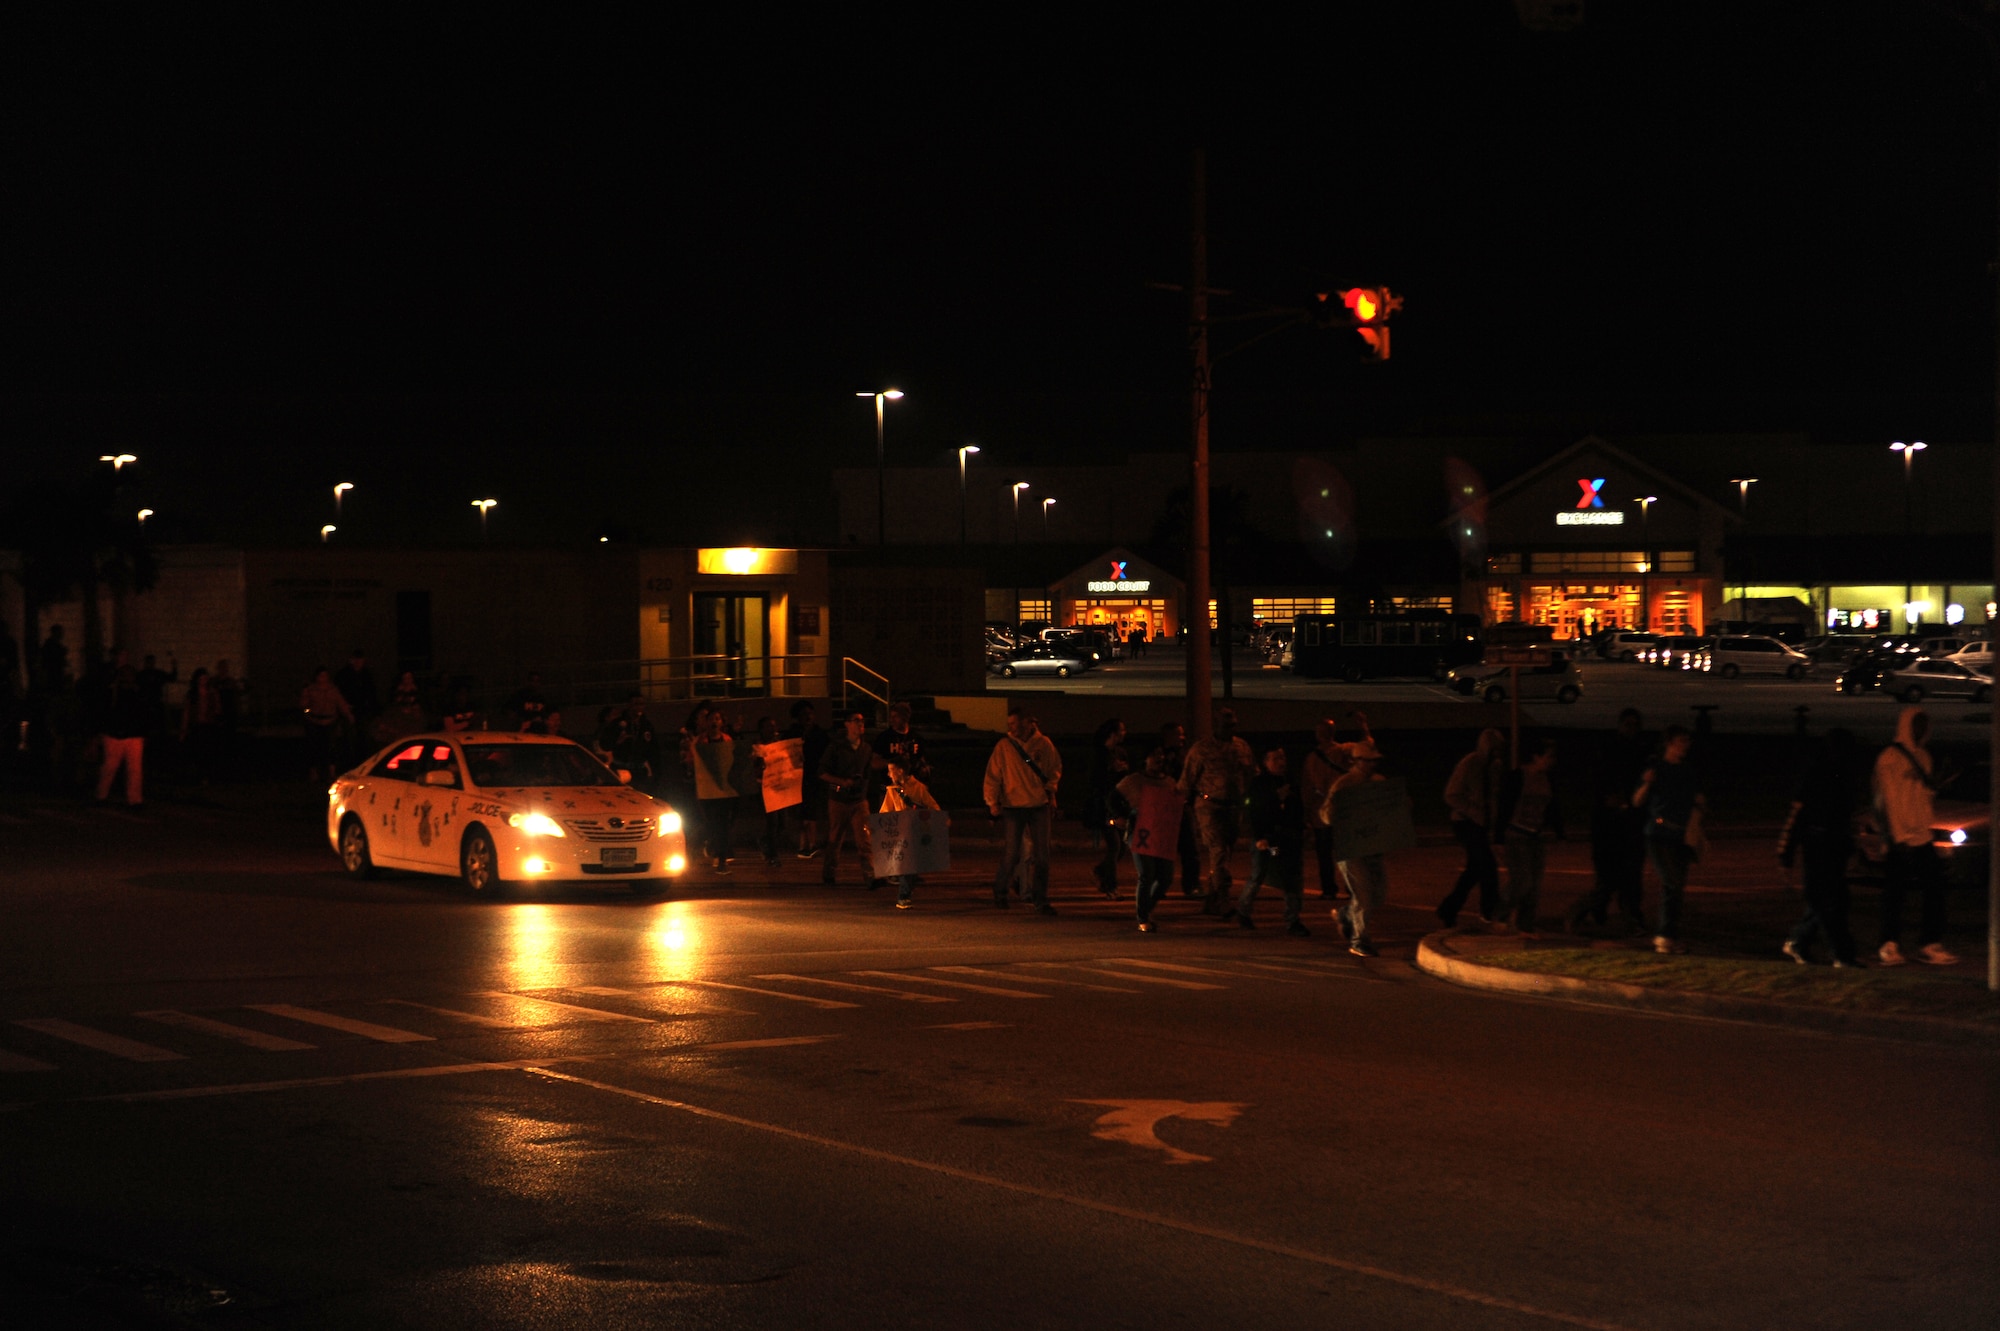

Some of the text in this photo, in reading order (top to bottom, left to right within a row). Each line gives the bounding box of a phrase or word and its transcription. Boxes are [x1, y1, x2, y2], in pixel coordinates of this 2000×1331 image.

[647, 577, 673, 592] 420
[1088, 581, 1150, 592] FOOD COURT
[470, 801, 502, 817] POLICE
